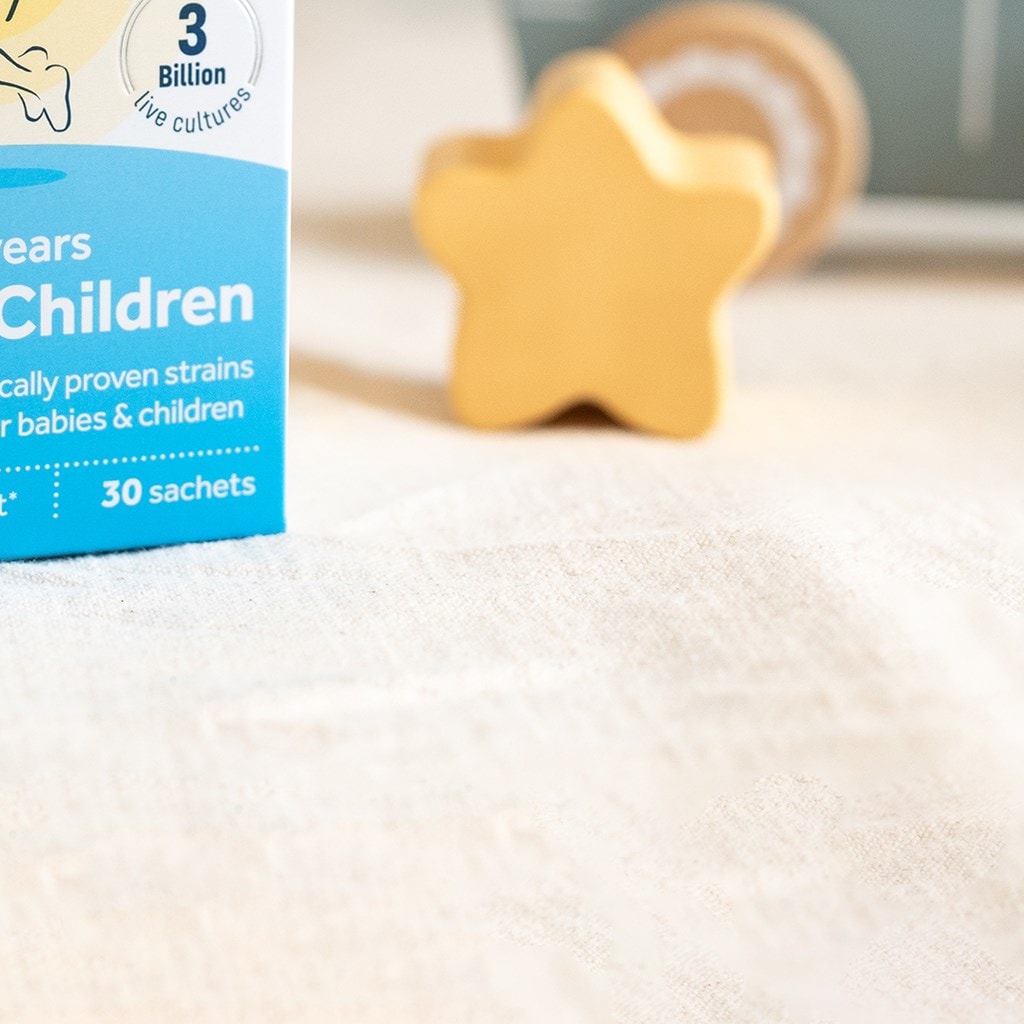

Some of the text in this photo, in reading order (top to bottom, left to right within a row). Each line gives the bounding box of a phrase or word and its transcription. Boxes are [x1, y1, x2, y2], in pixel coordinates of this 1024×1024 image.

[178, 2, 207, 56] 3
[159, 64, 226, 88] Billion
[134, 87, 251, 133] live cultures
[65, 367, 158, 399] proven
[164, 356, 254, 386] strains
[18, 408, 107, 437] babies
[113, 402, 132, 429] &
[138, 397, 244, 427] children
[100, 473, 256, 508] 30 sachets
